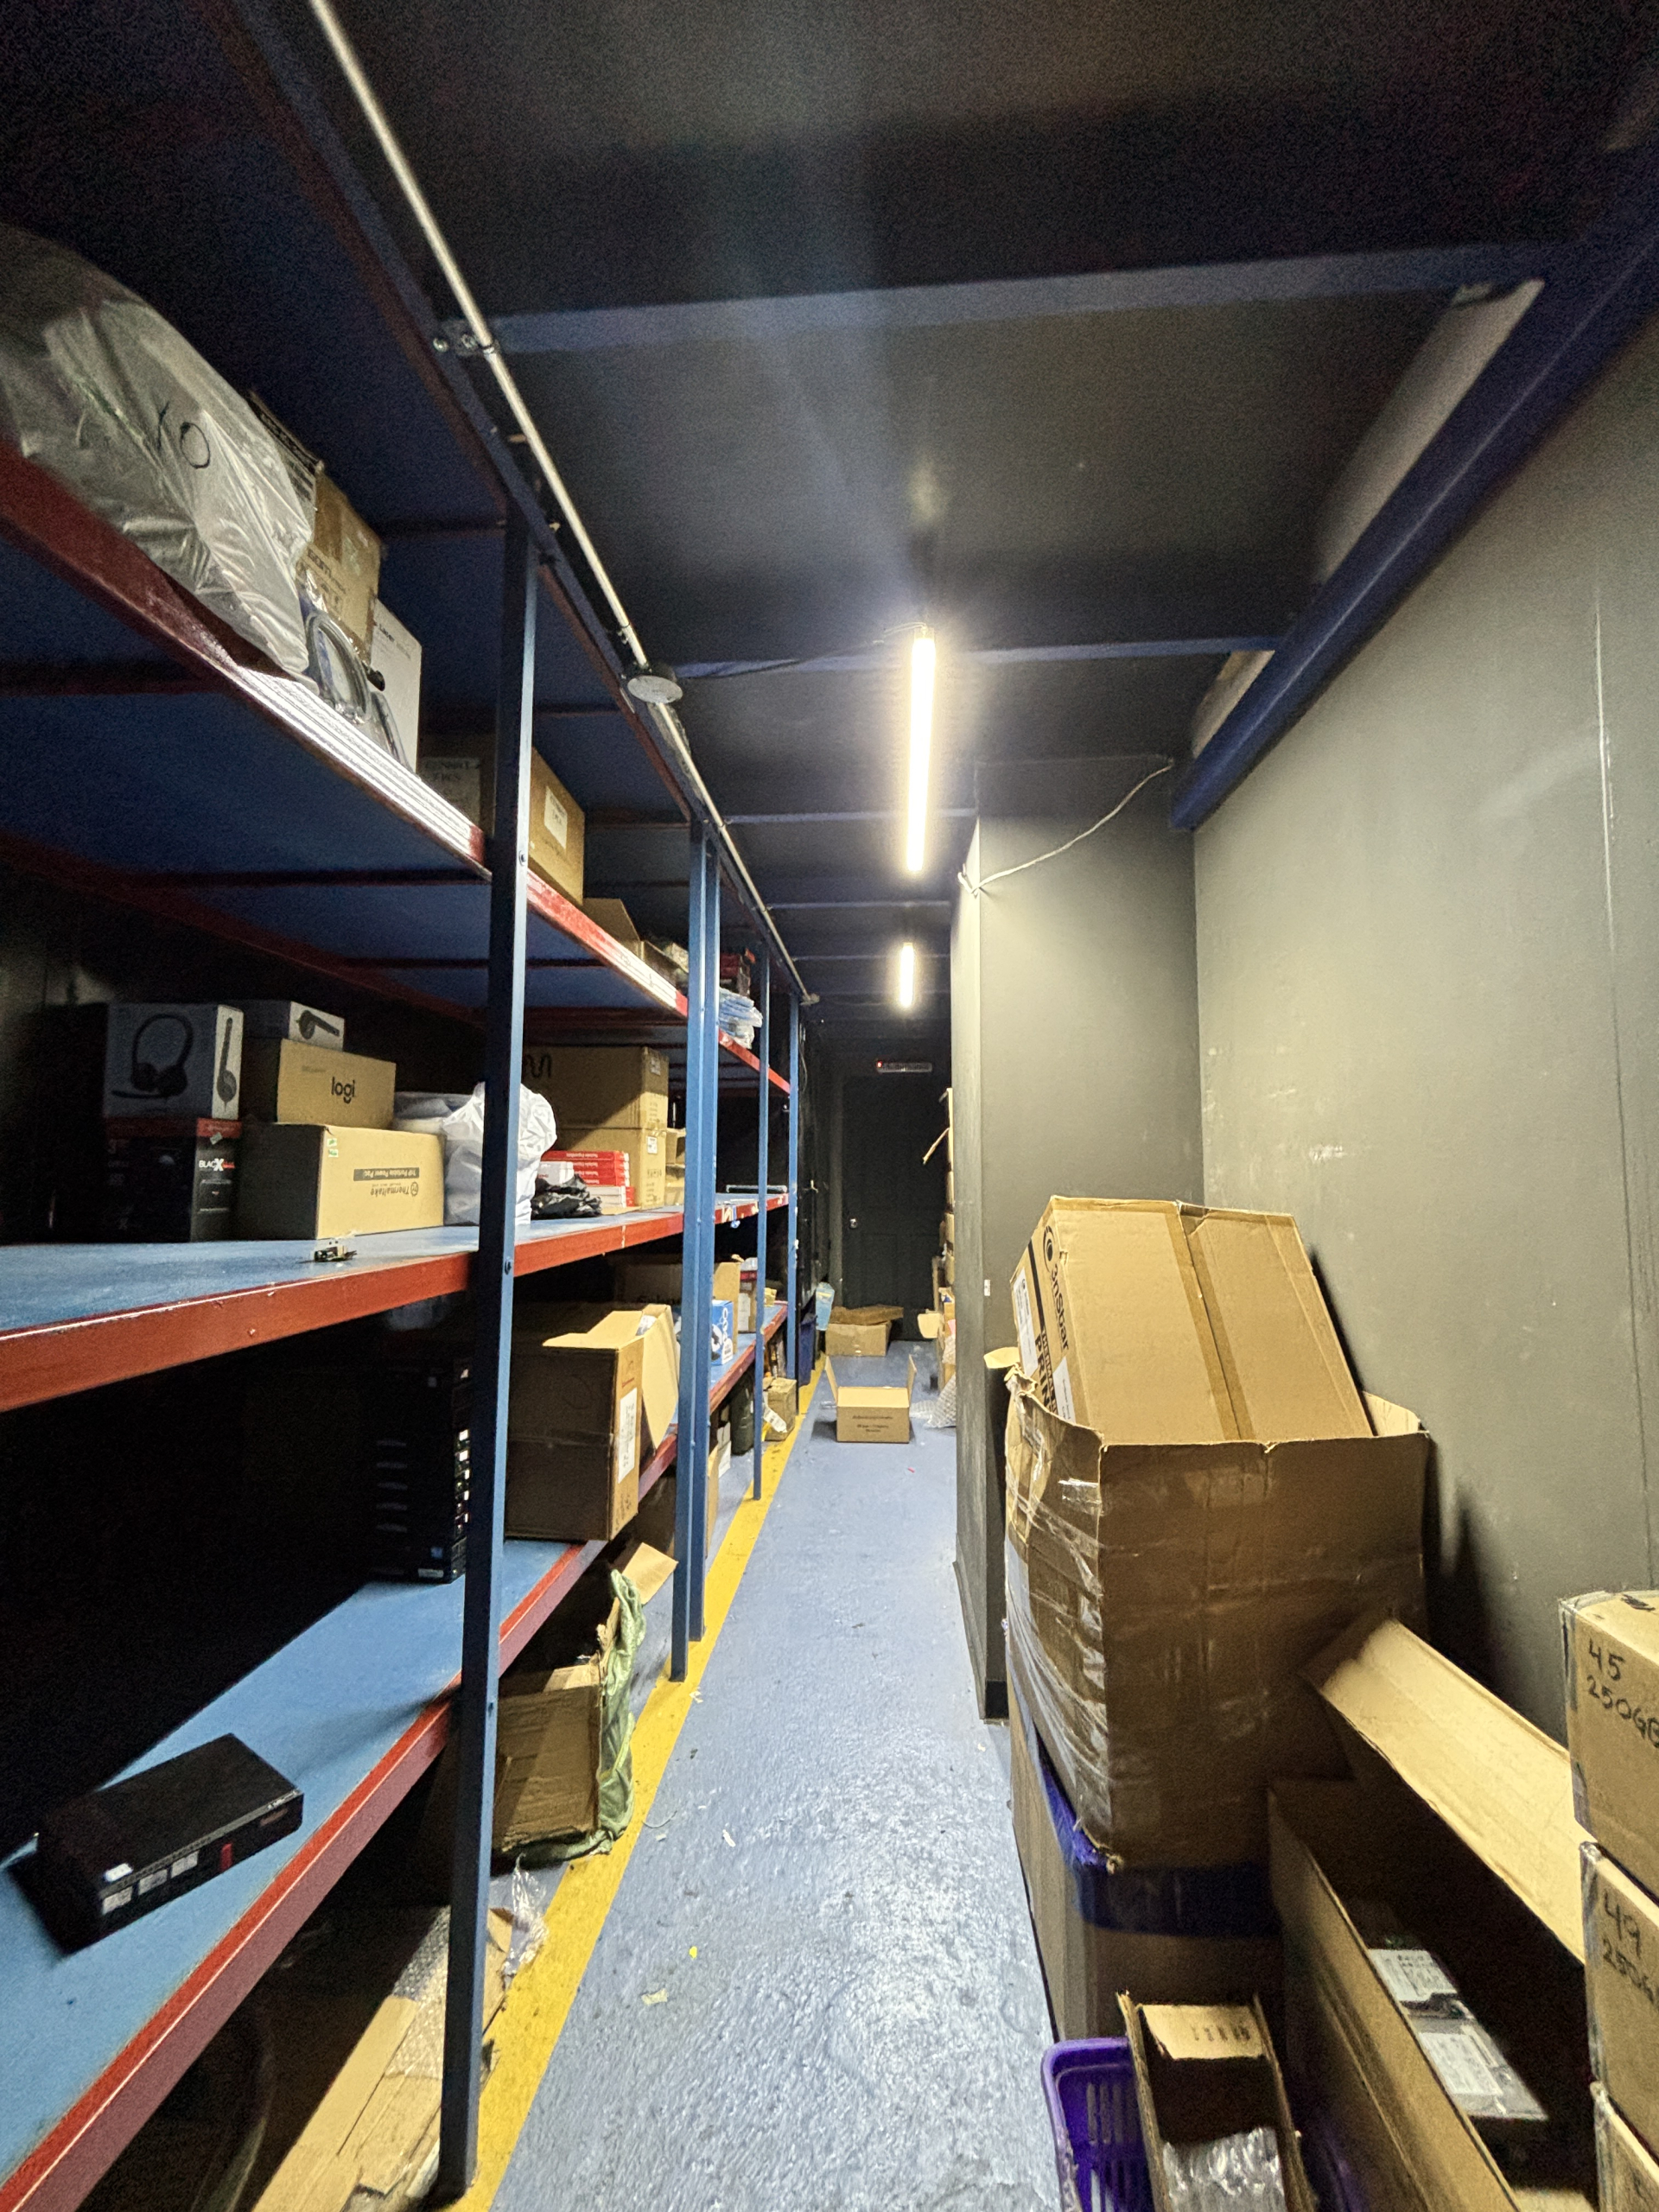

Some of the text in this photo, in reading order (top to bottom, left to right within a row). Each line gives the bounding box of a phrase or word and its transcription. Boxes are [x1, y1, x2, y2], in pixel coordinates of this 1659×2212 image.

[331, 1077, 356, 1104] logi
[370, 1185, 410, 1198] Thermaltake
[1052, 1263, 1069, 1351] 3nStar
[1588, 1637, 1625, 1681] 45
[1603, 1889, 1641, 1960] 49
[1603, 1936, 1659, 2012] 250G
